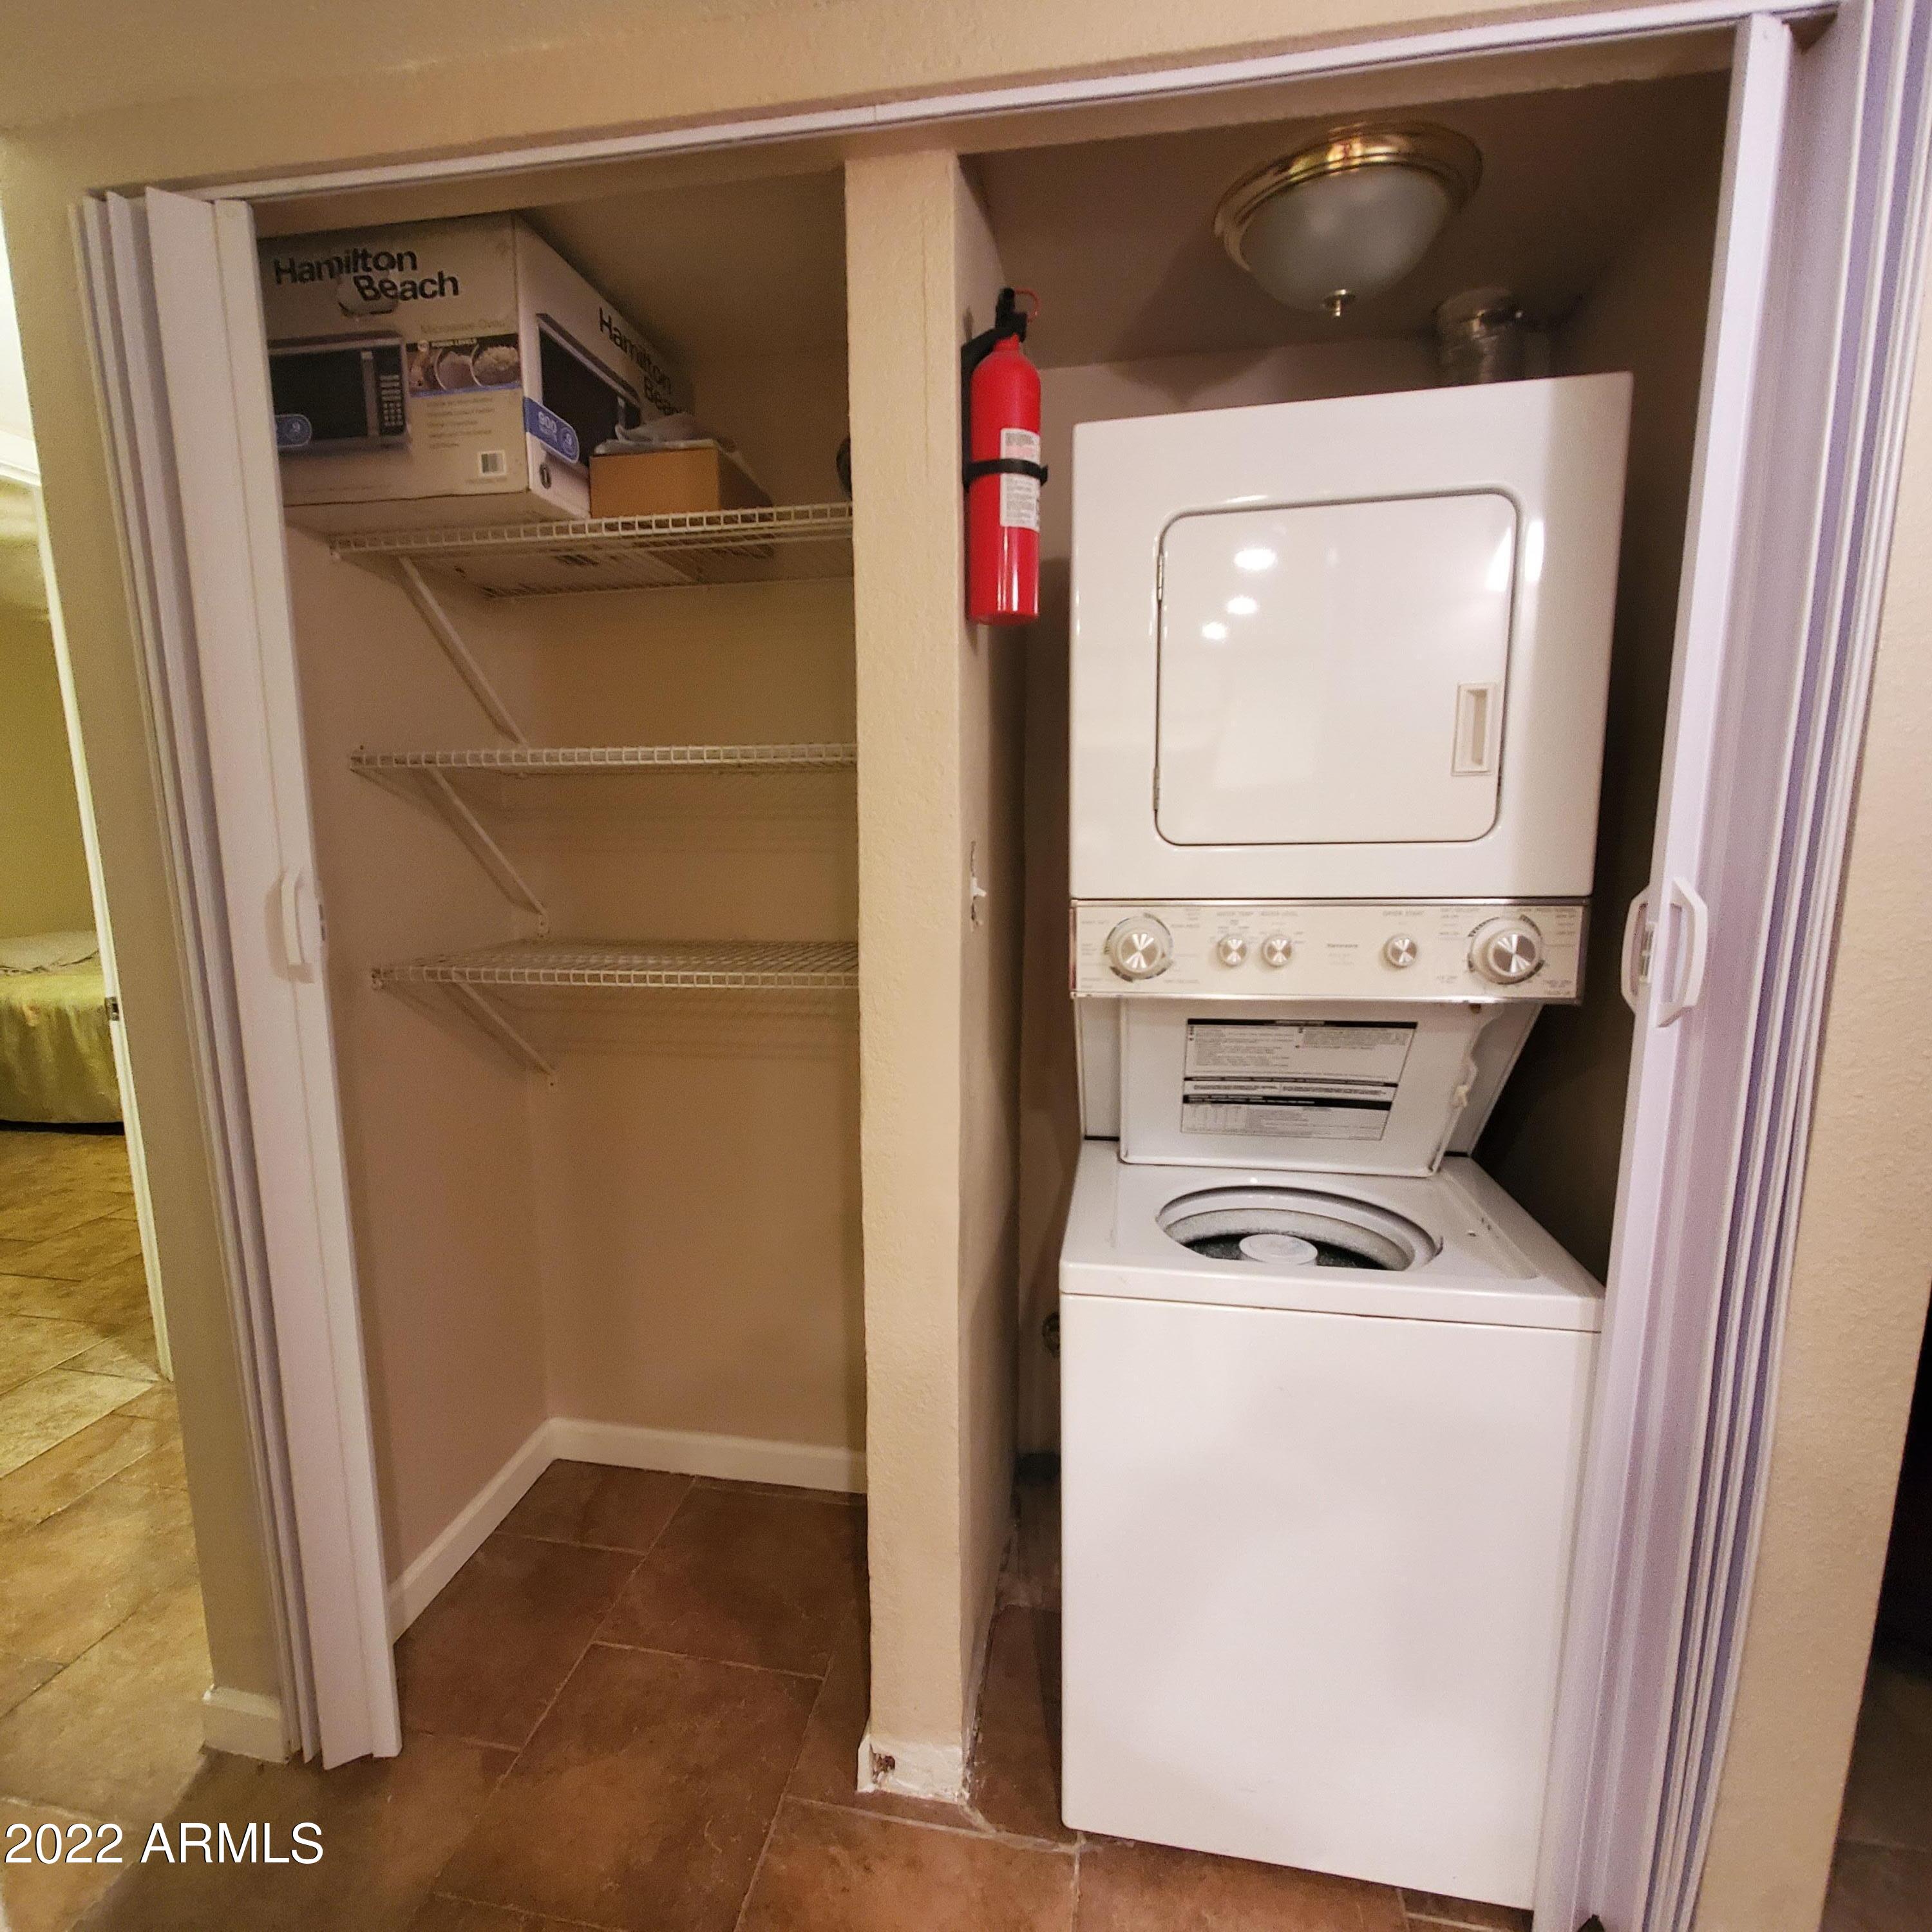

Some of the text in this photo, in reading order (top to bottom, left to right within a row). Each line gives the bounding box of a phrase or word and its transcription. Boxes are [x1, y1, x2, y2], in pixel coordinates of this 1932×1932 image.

[274, 247, 417, 285] Hamilton
[353, 270, 459, 301] Beach
[599, 307, 671, 395] Hamilton
